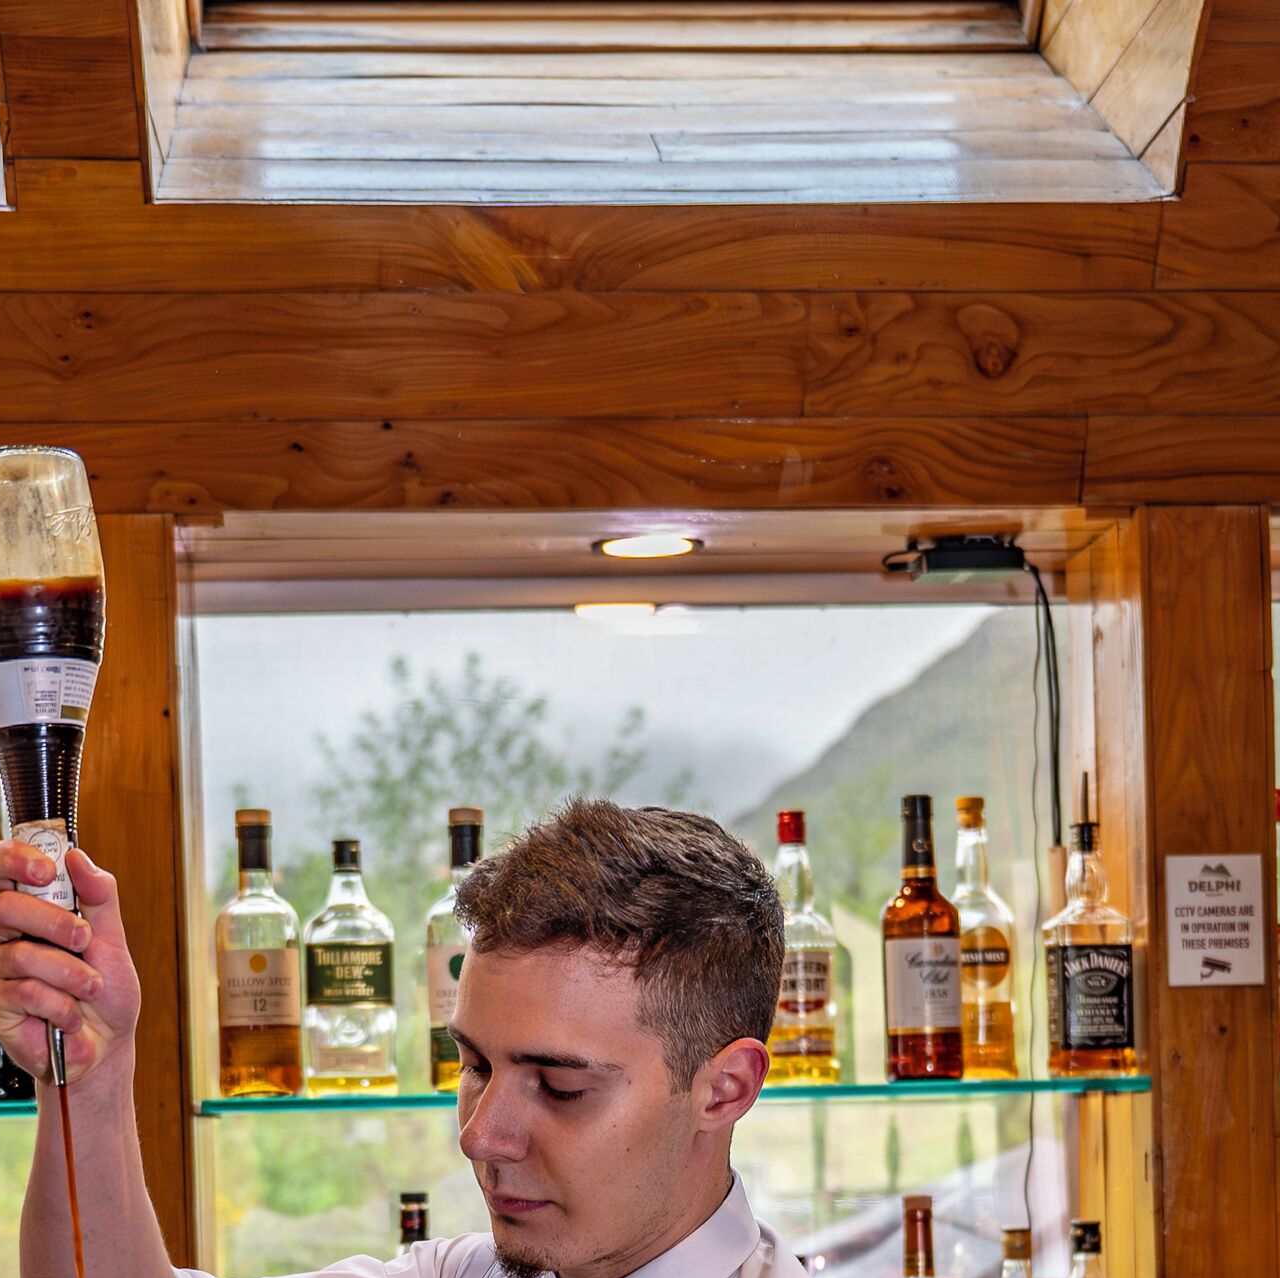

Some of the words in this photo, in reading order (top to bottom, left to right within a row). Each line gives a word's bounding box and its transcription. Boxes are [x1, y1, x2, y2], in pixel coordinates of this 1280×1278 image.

[1188, 880, 1241, 893] DELPHI
[52, 891, 68, 900] ITEM
[1174, 906, 1195, 918] CCTV
[1198, 905, 1236, 918] CAMERAS
[1238, 905, 1255, 917] ARE
[1181, 922, 1189, 934] IN
[1191, 922, 1235, 934] OPERATION
[1238, 922, 1249, 933] ON
[1181, 939, 1206, 950] THESE
[1208, 938, 1249, 949] PREMISES
[315, 949, 383, 966] TULLAMORE
[961, 952, 983, 963] RISH
[985, 951, 1006, 963] MIST
[1064, 957, 1090, 978] JACK
[1089, 952, 1129, 978] DANIEL'S
[227, 977, 268, 988] YELLOW
[269, 977, 291, 988] SPOT
[253, 999, 267, 1012] 12
[1076, 1008, 1119, 1016] WHISKEY
